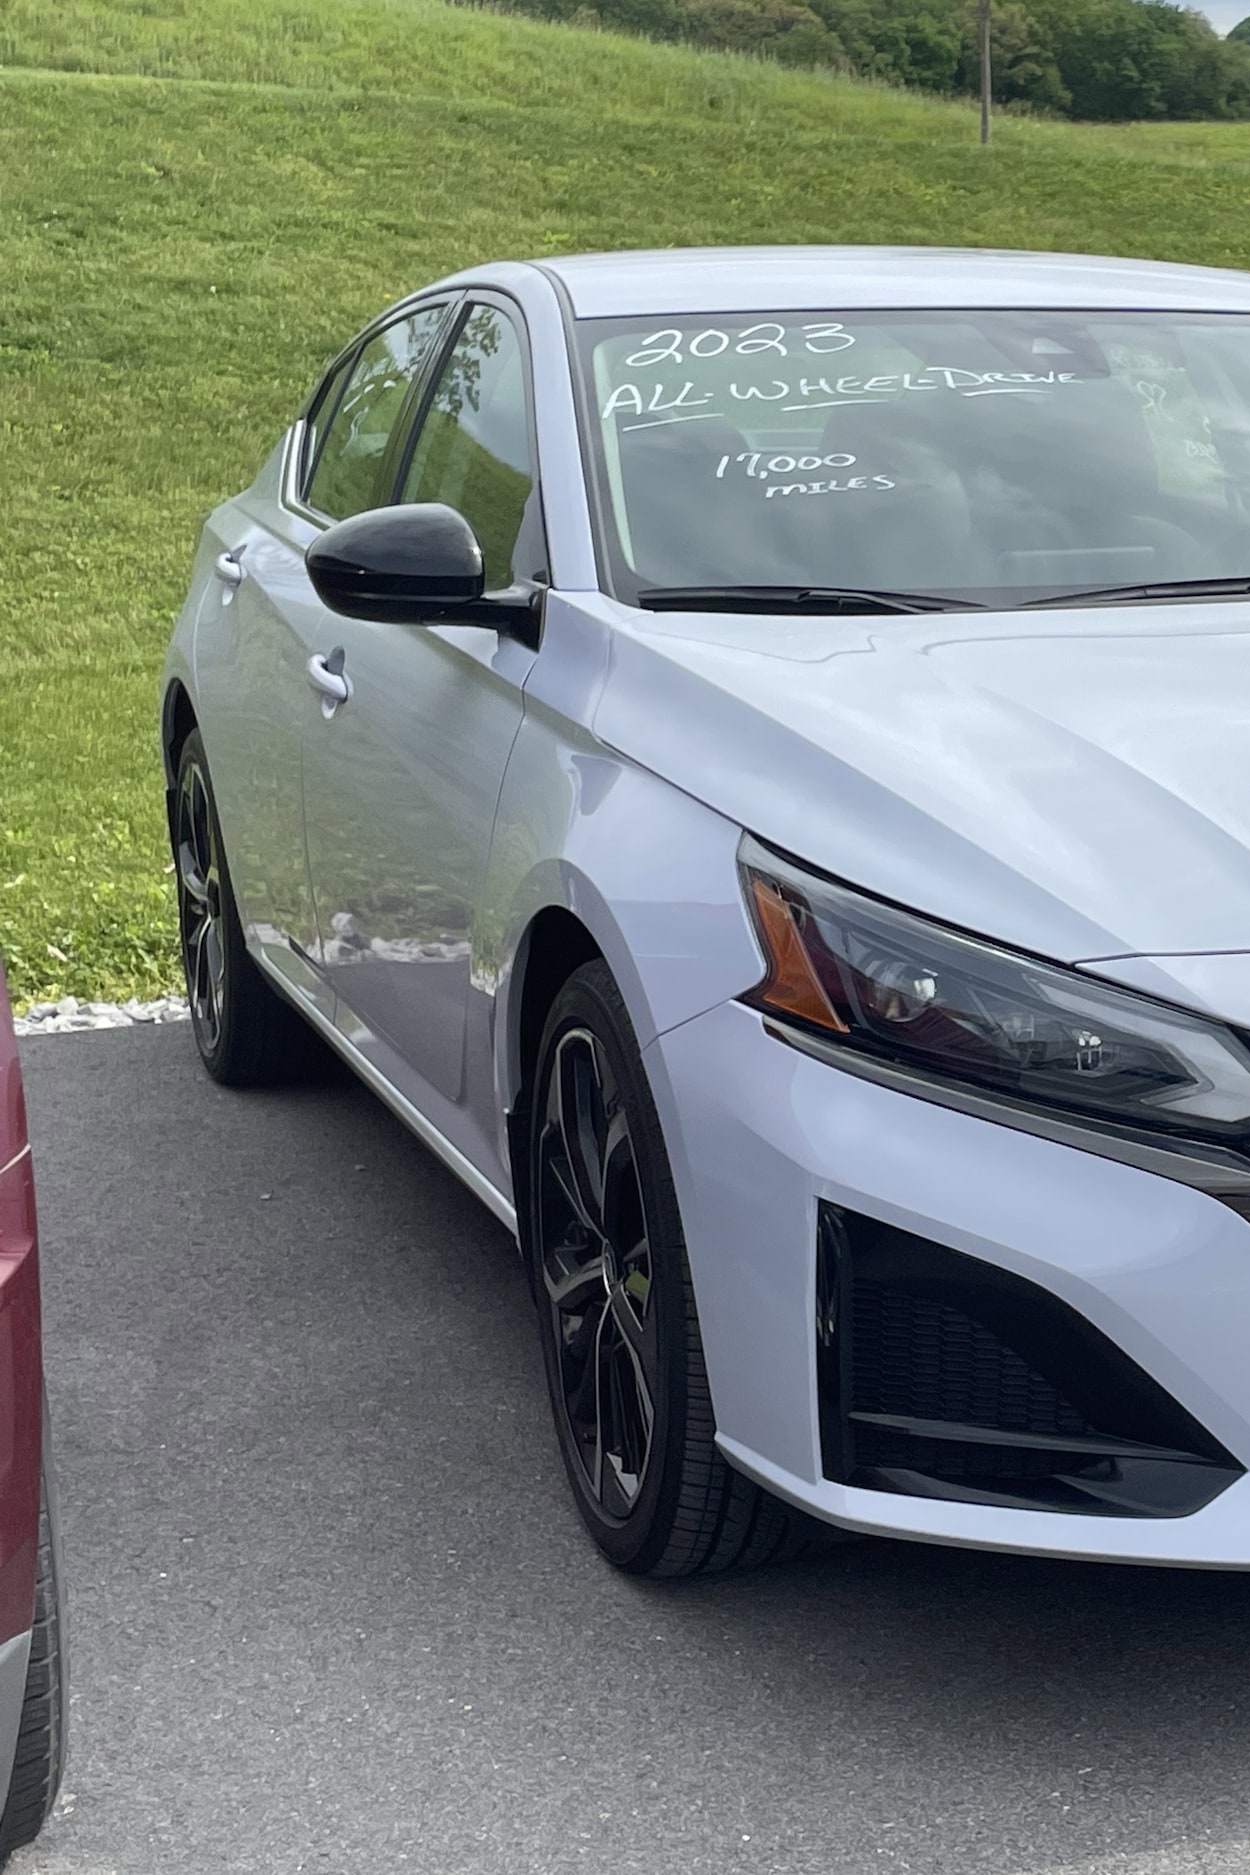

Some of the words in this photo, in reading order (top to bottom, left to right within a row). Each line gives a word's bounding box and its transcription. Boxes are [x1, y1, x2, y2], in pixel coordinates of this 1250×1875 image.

[625, 322, 857, 367] 2023
[715, 452, 858, 480] 17,000
[765, 474, 897, 499] MILES
